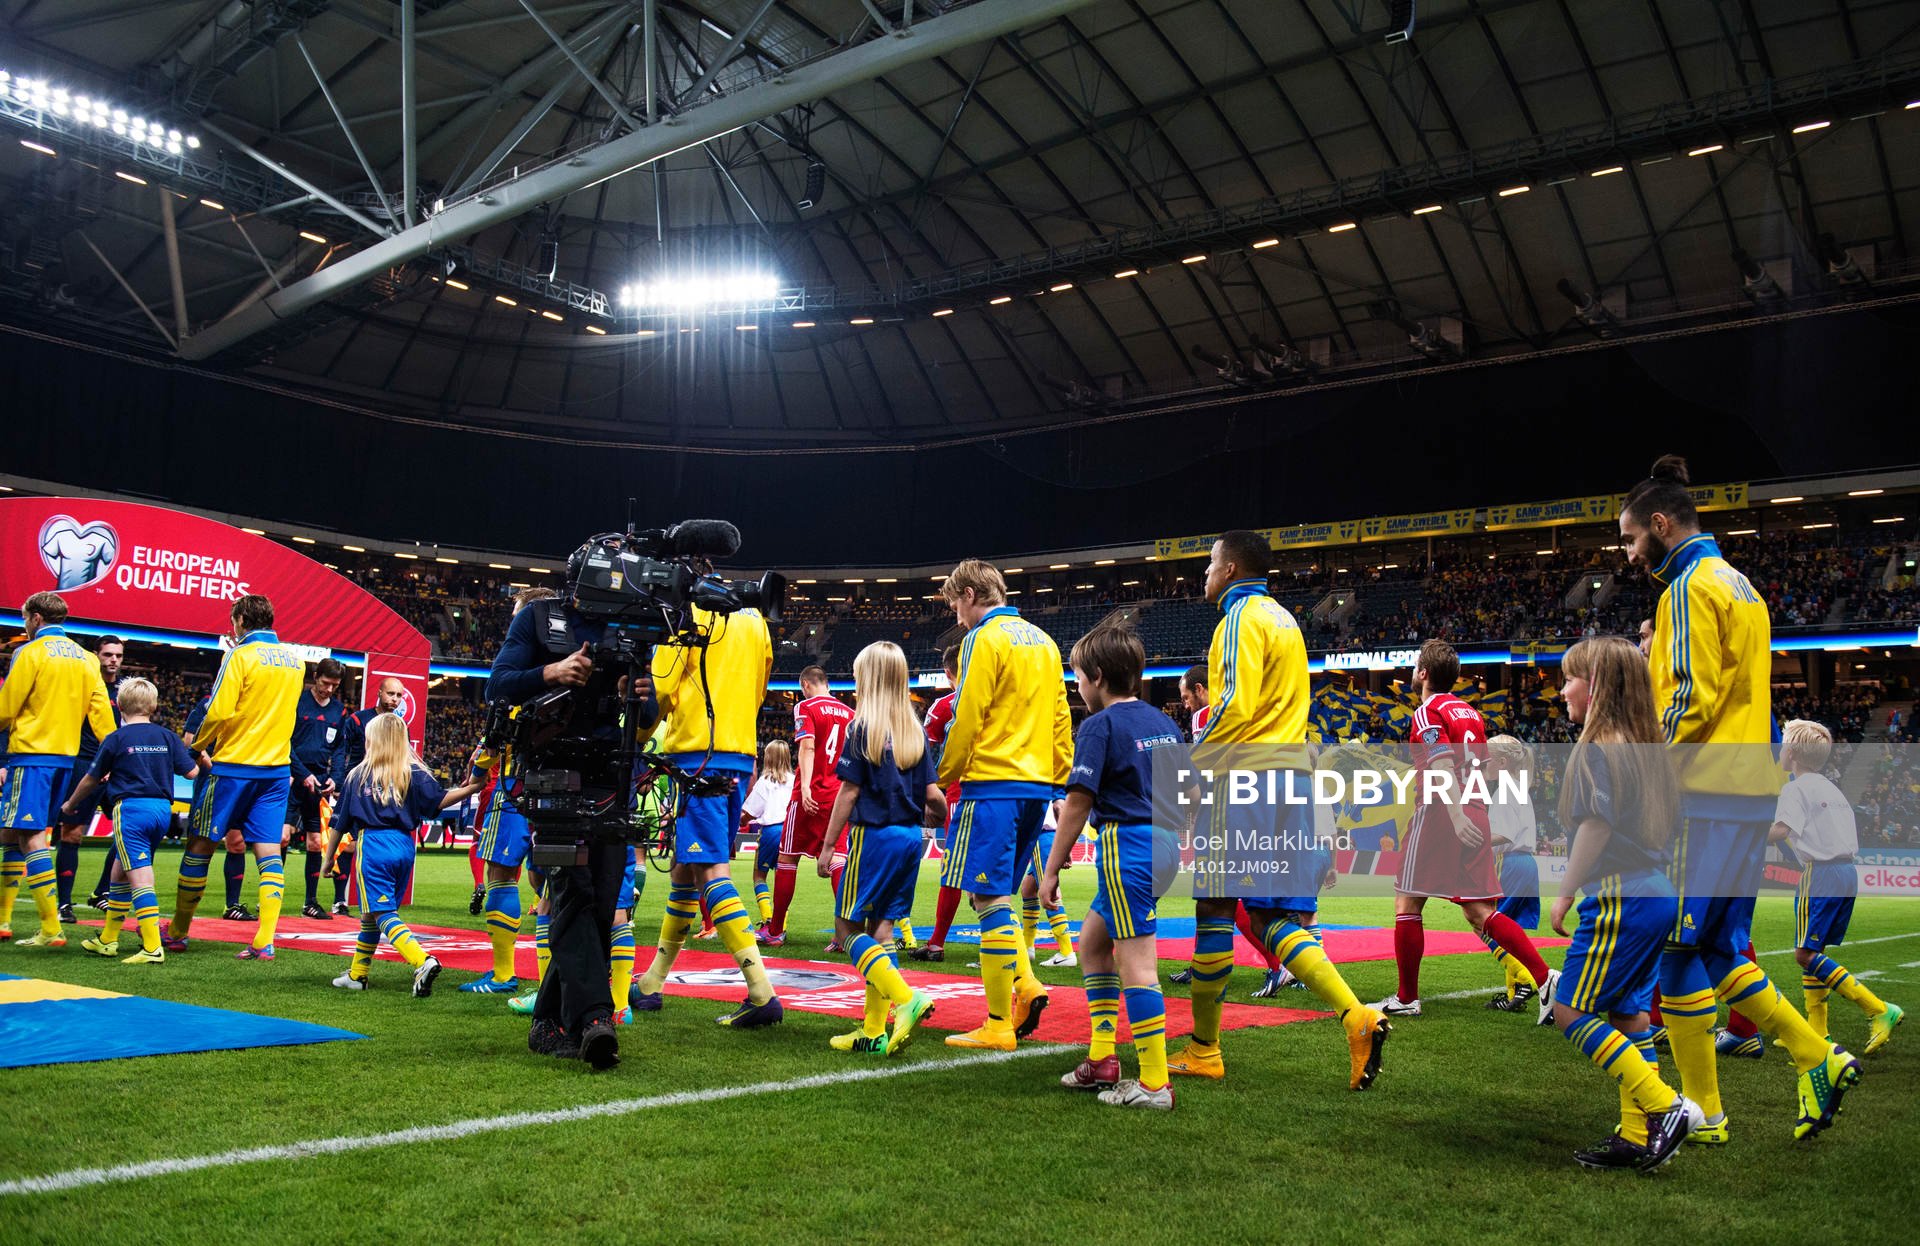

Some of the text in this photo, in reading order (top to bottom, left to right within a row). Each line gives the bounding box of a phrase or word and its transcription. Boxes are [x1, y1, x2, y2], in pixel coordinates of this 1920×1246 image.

[1515, 501, 1582, 518] CAMP SWEDEN
[1279, 528, 1300, 539] CAMP
[1302, 525, 1333, 537] SWEDEN
[1386, 514, 1448, 529] CAMP SWEDEN
[133, 545, 240, 579] EUROPEAN
[116, 564, 251, 602] QUALIFIERS
[257, 647, 301, 670] SVERIGE
[819, 705, 850, 719] KAUFMANN
[825, 723, 840, 765] 4
[852, 1032, 886, 1053] NIKE
